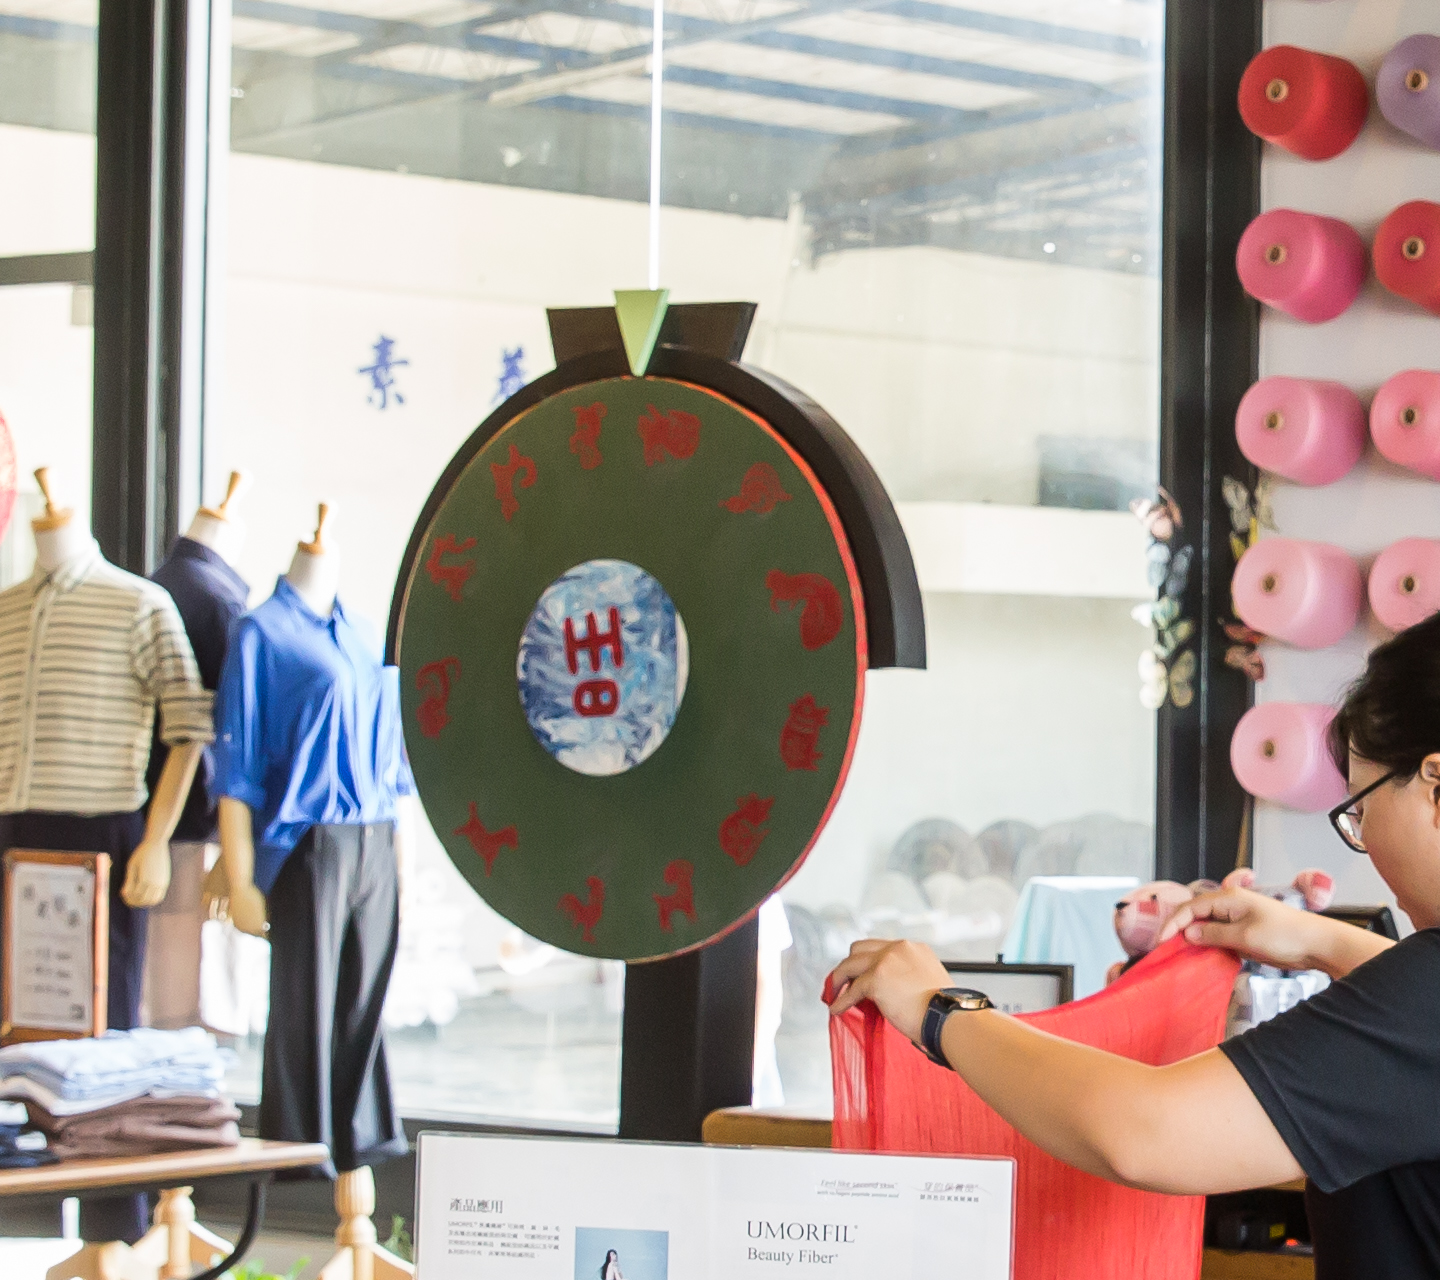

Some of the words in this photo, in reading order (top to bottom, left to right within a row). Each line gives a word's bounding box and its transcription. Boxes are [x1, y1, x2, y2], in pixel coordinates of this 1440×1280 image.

[449, 1197, 504, 1214] 產品應用
[747, 1247, 794, 1265] Beauty
[798, 1249, 835, 1264] Fiber
